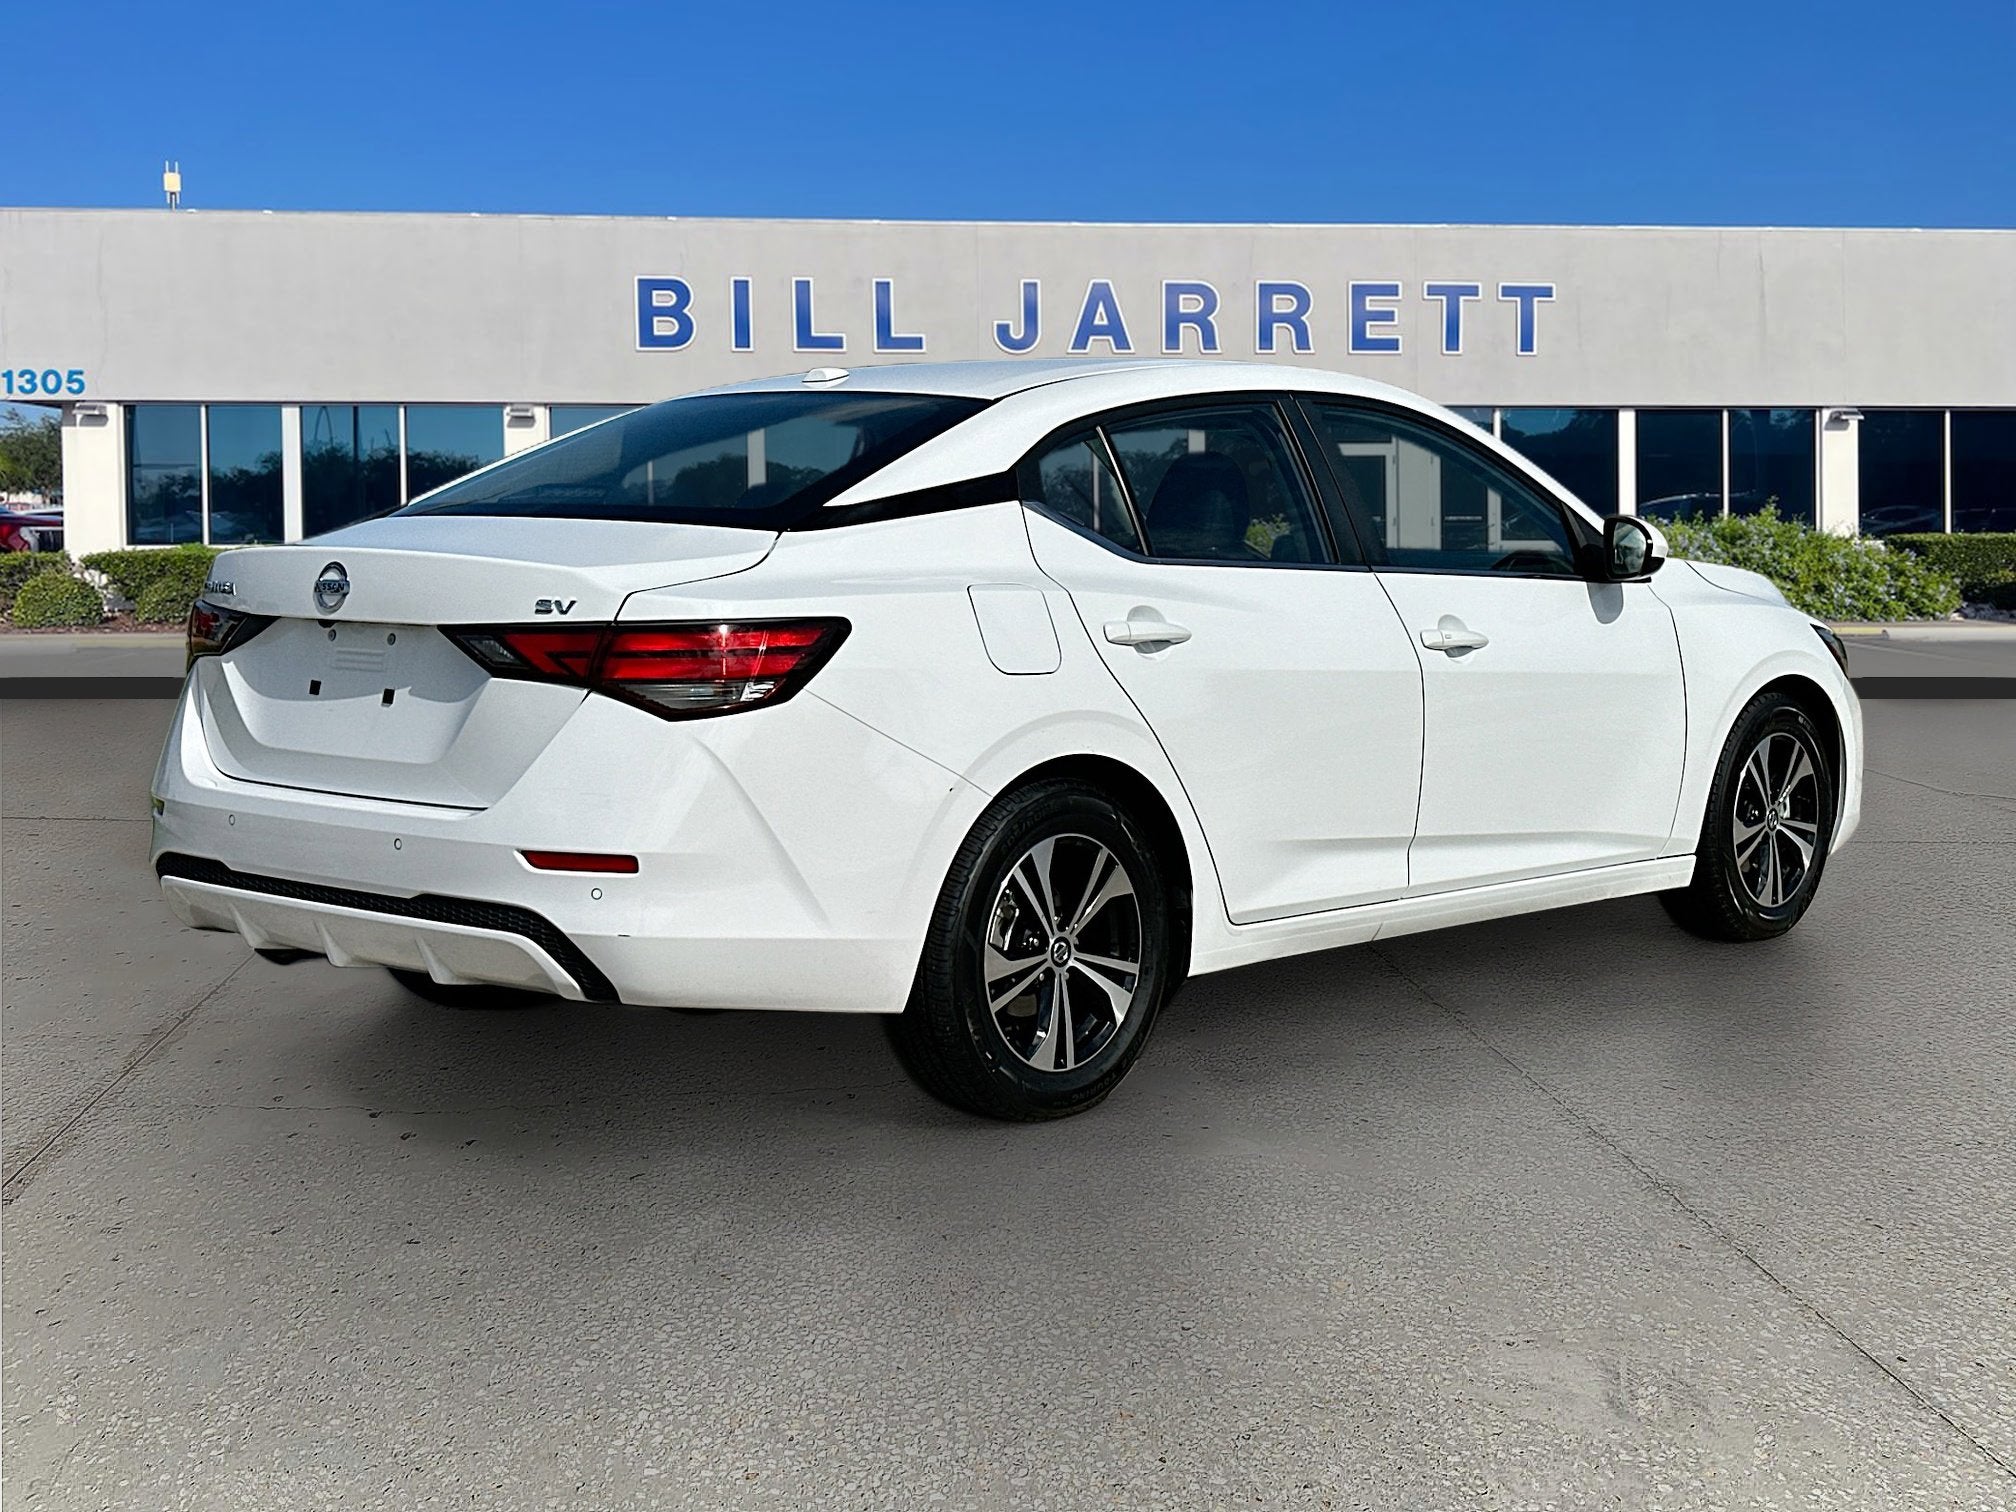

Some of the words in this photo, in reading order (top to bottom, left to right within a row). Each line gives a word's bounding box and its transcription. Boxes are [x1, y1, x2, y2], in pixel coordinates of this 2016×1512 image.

[635, 275, 926, 353] BILL
[993, 278, 1557, 356] JARRETT
[1, 368, 86, 395] 1305
[534, 599, 577, 615] SV
